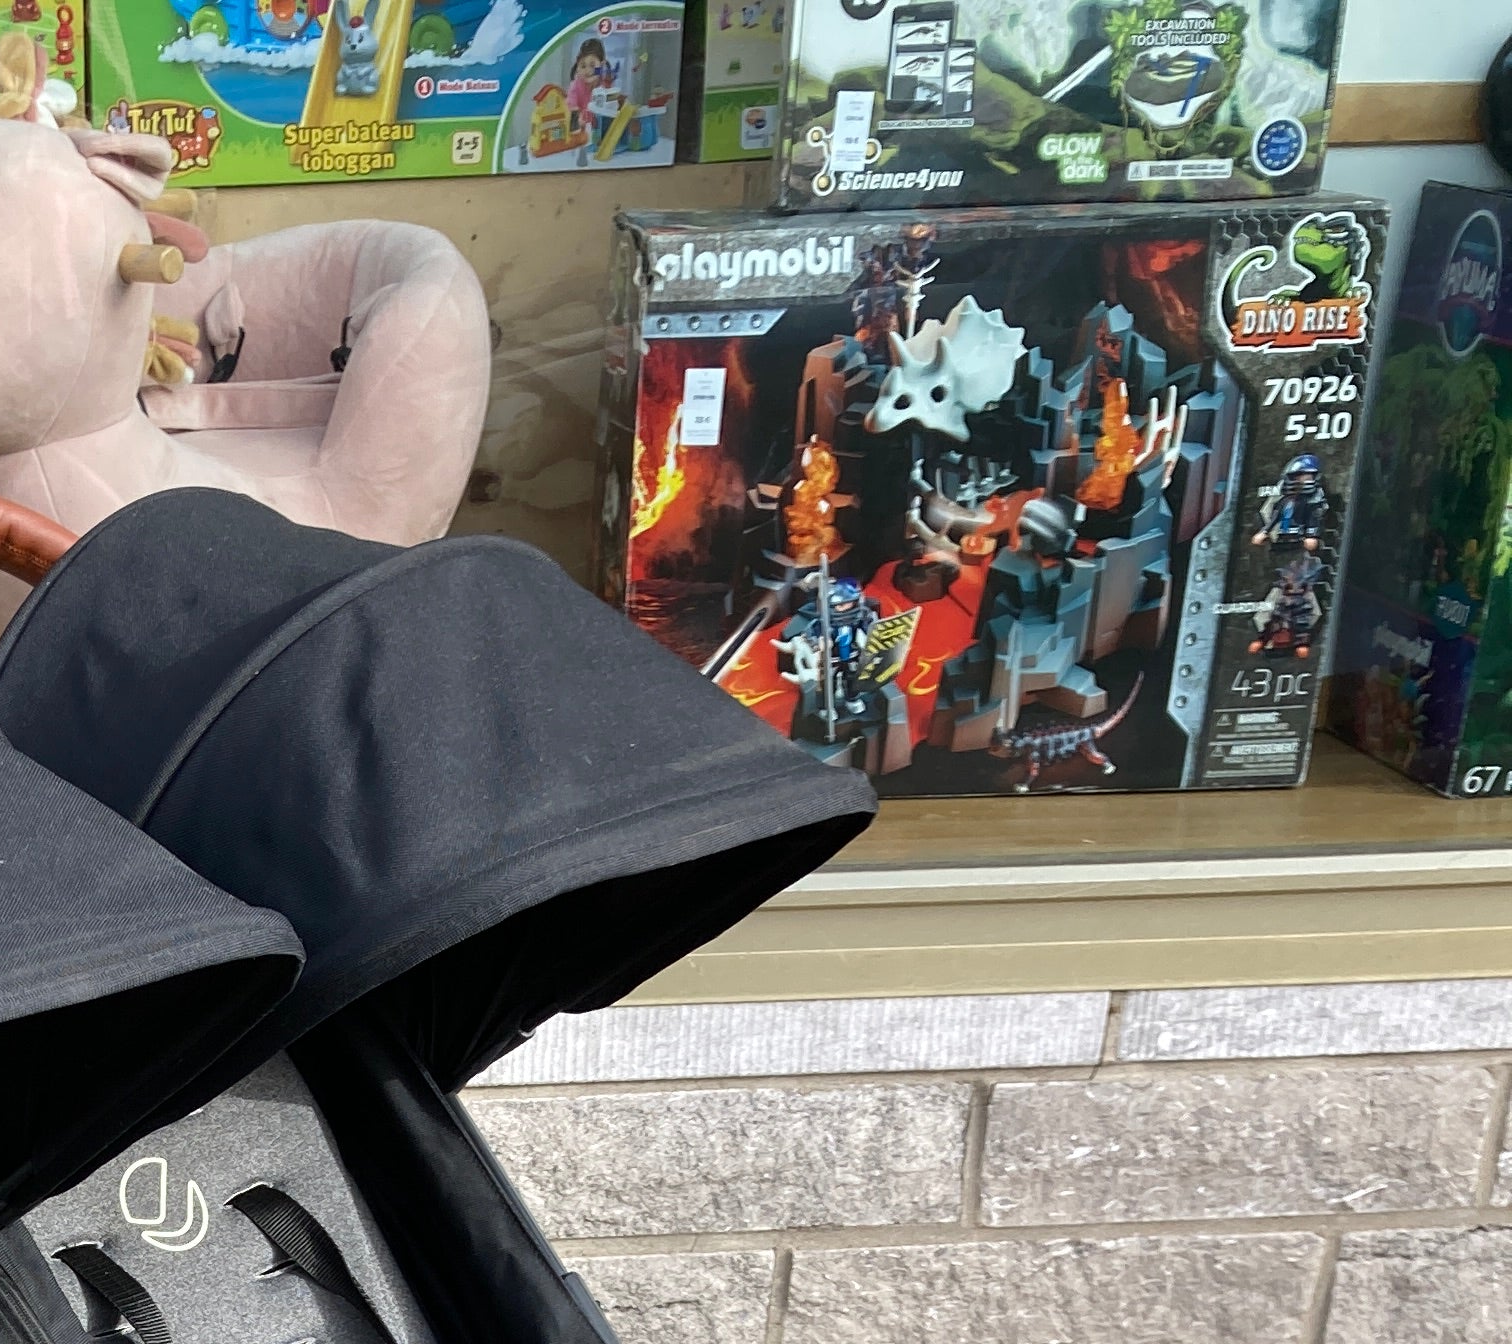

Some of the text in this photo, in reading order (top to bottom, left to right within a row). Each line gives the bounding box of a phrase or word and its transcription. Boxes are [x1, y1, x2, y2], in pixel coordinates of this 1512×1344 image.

[1144, 18, 1216, 31] EXCAVATION
[1131, 33, 1231, 46] TOOLS INCLUDED!
[128, 107, 195, 136] Tut Tut
[283, 119, 416, 149] Super bateau
[455, 136, 480, 150] 1-5
[1042, 135, 1101, 156] GLOW
[302, 148, 396, 176] toboggan
[1063, 160, 1105, 179] dark
[838, 168, 965, 191] Science4you
[652, 235, 855, 292] playmobil
[1242, 305, 1351, 336] DINO RISE
[1262, 374, 1358, 407] 70926
[1284, 411, 1353, 442] 5-10
[1230, 668, 1313, 703] 43 pc
[1462, 765, 1502, 794] 67
